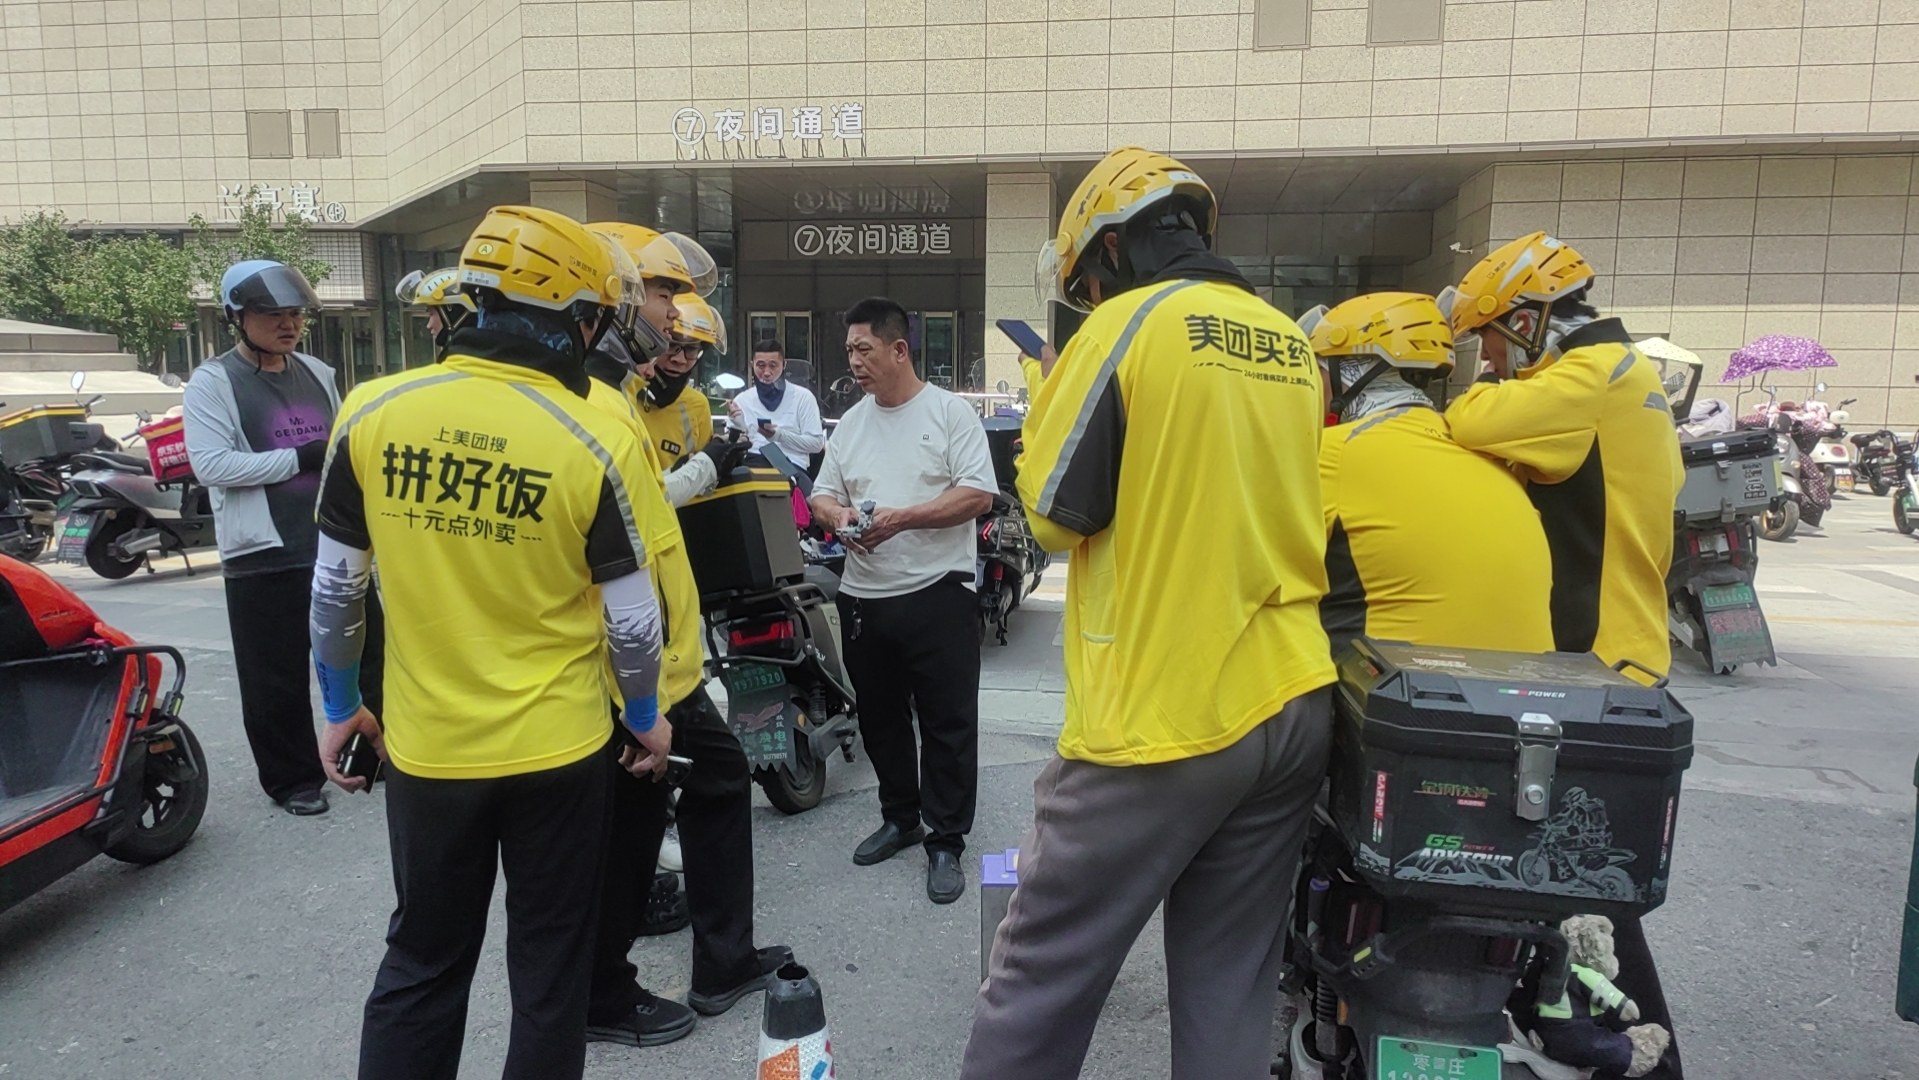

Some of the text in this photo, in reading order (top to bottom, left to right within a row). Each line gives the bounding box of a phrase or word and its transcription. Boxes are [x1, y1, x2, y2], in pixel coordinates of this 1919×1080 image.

[1184, 314, 1312, 375] 美团买药
[433, 426, 507, 453] 上美团搜
[382, 442, 552, 523] 拼好饭
[403, 507, 516, 545] 十元点外卖
[1528, 690, 1566, 698] POWER
[1425, 834, 1464, 850] GS
